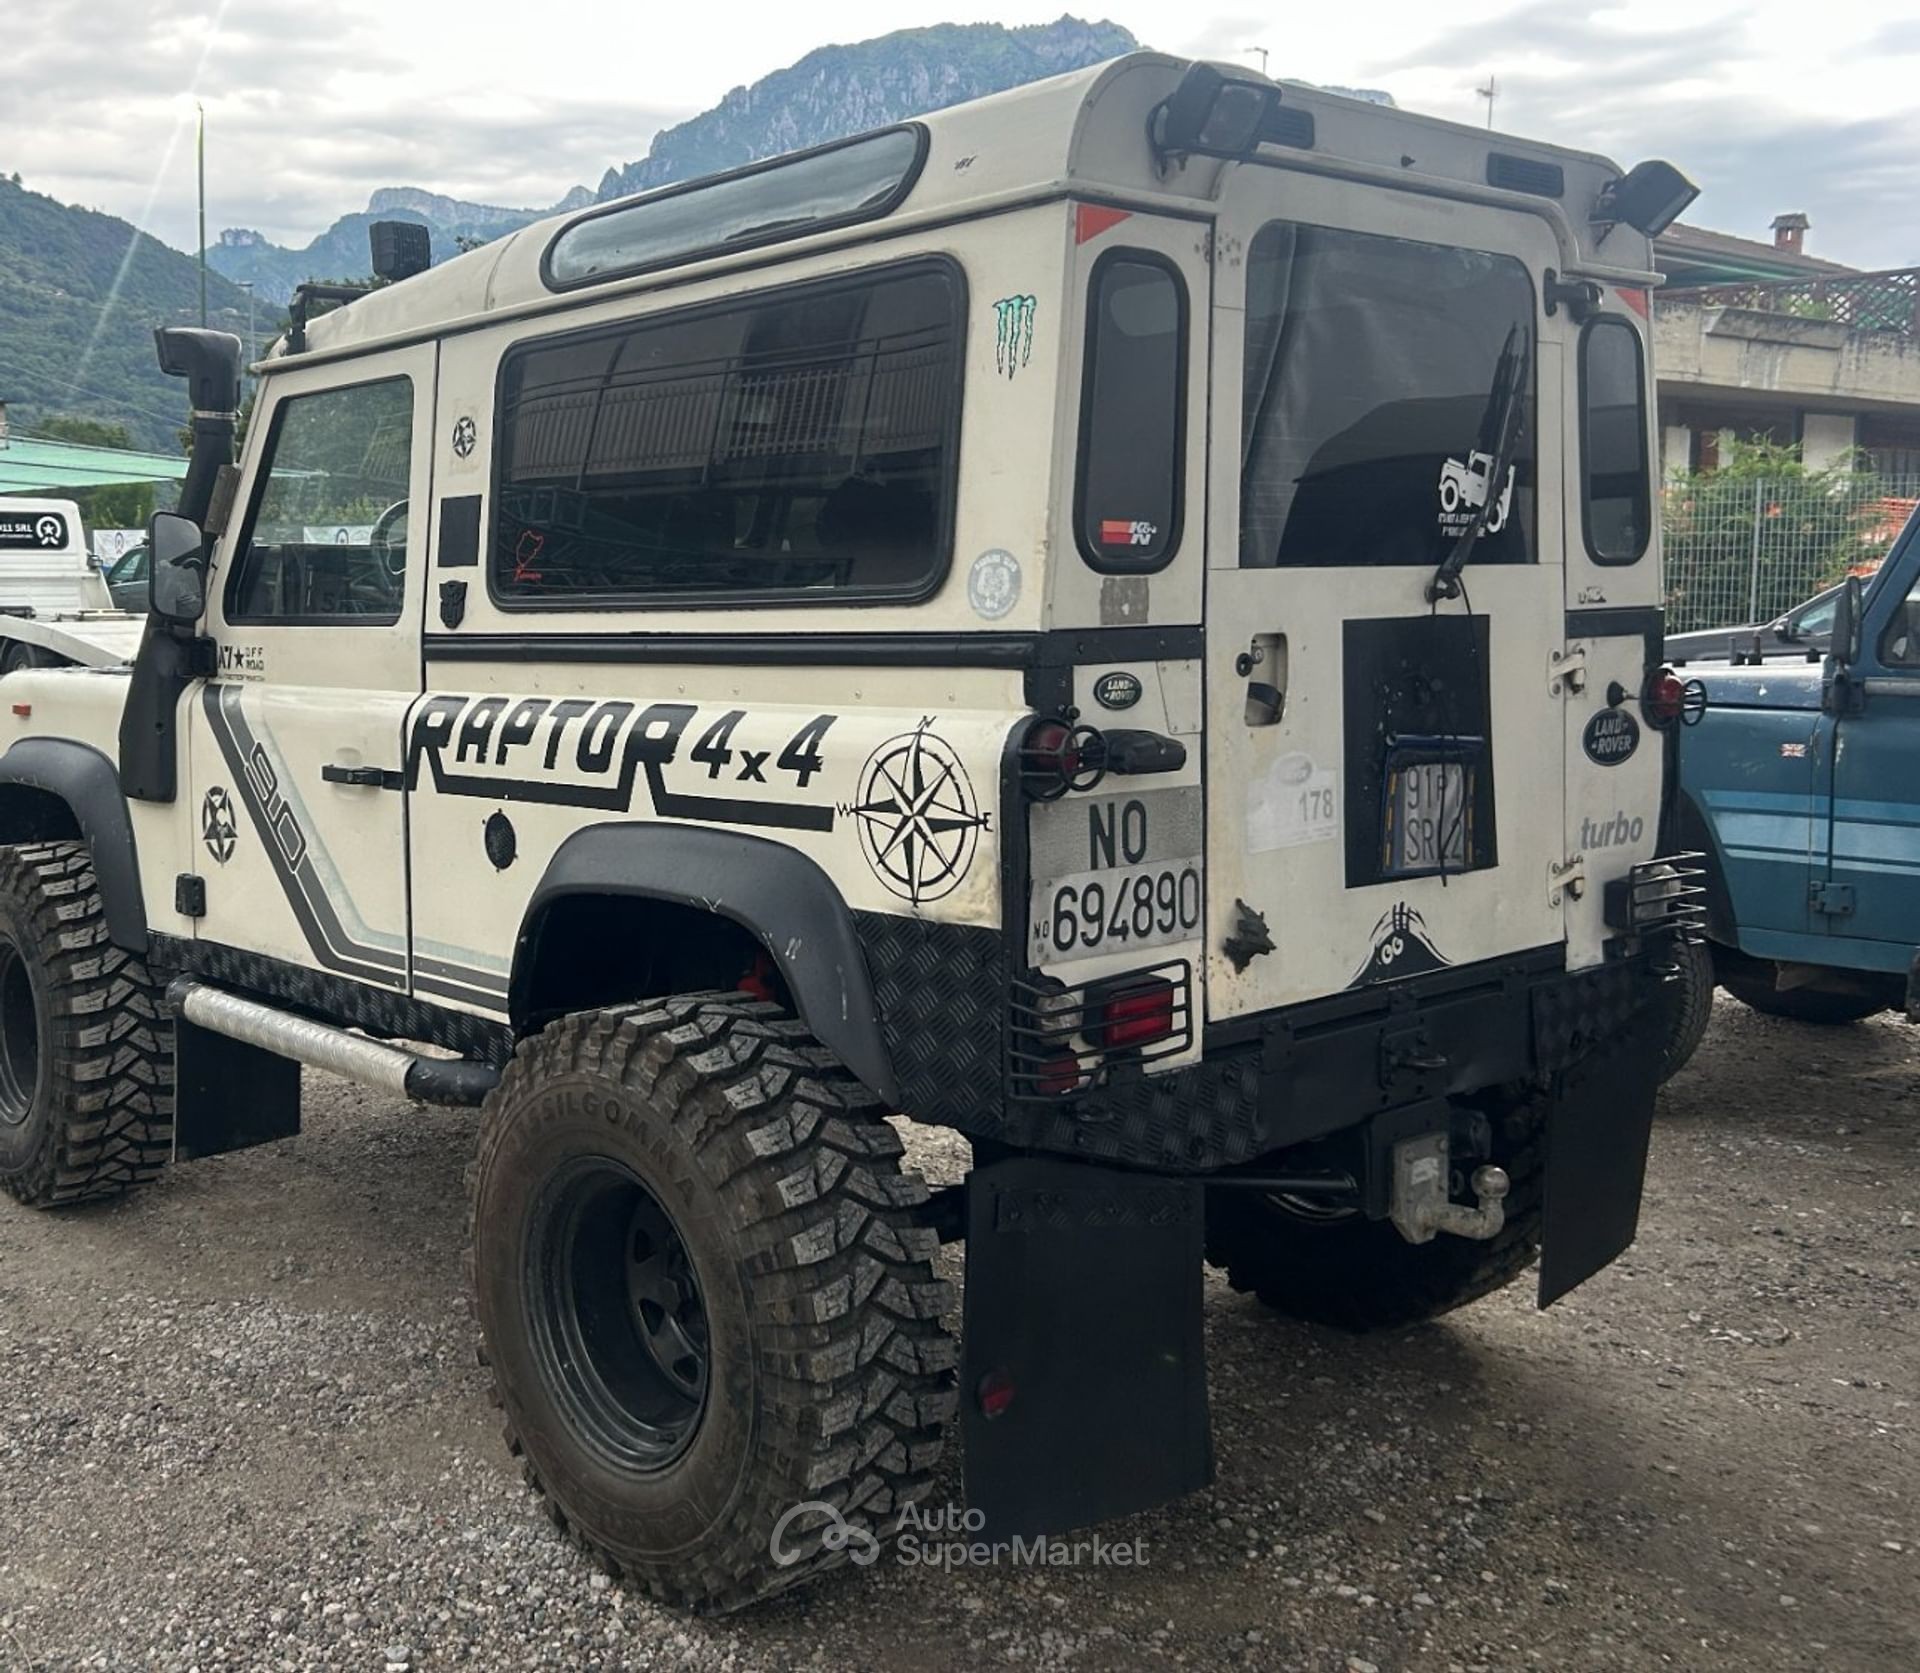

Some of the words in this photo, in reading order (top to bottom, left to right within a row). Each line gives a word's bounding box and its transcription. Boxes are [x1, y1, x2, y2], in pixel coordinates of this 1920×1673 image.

[1594, 717, 1623, 736] LAND
[1597, 733, 1632, 754] ROVER
[407, 695, 698, 806] RAPTOR
[690, 710, 838, 788] 4x4
[1299, 788, 1333, 822] 178
[1089, 799, 1147, 871] NO
[1581, 810, 1644, 851] turbo
[1053, 868, 1200, 951] 694890
